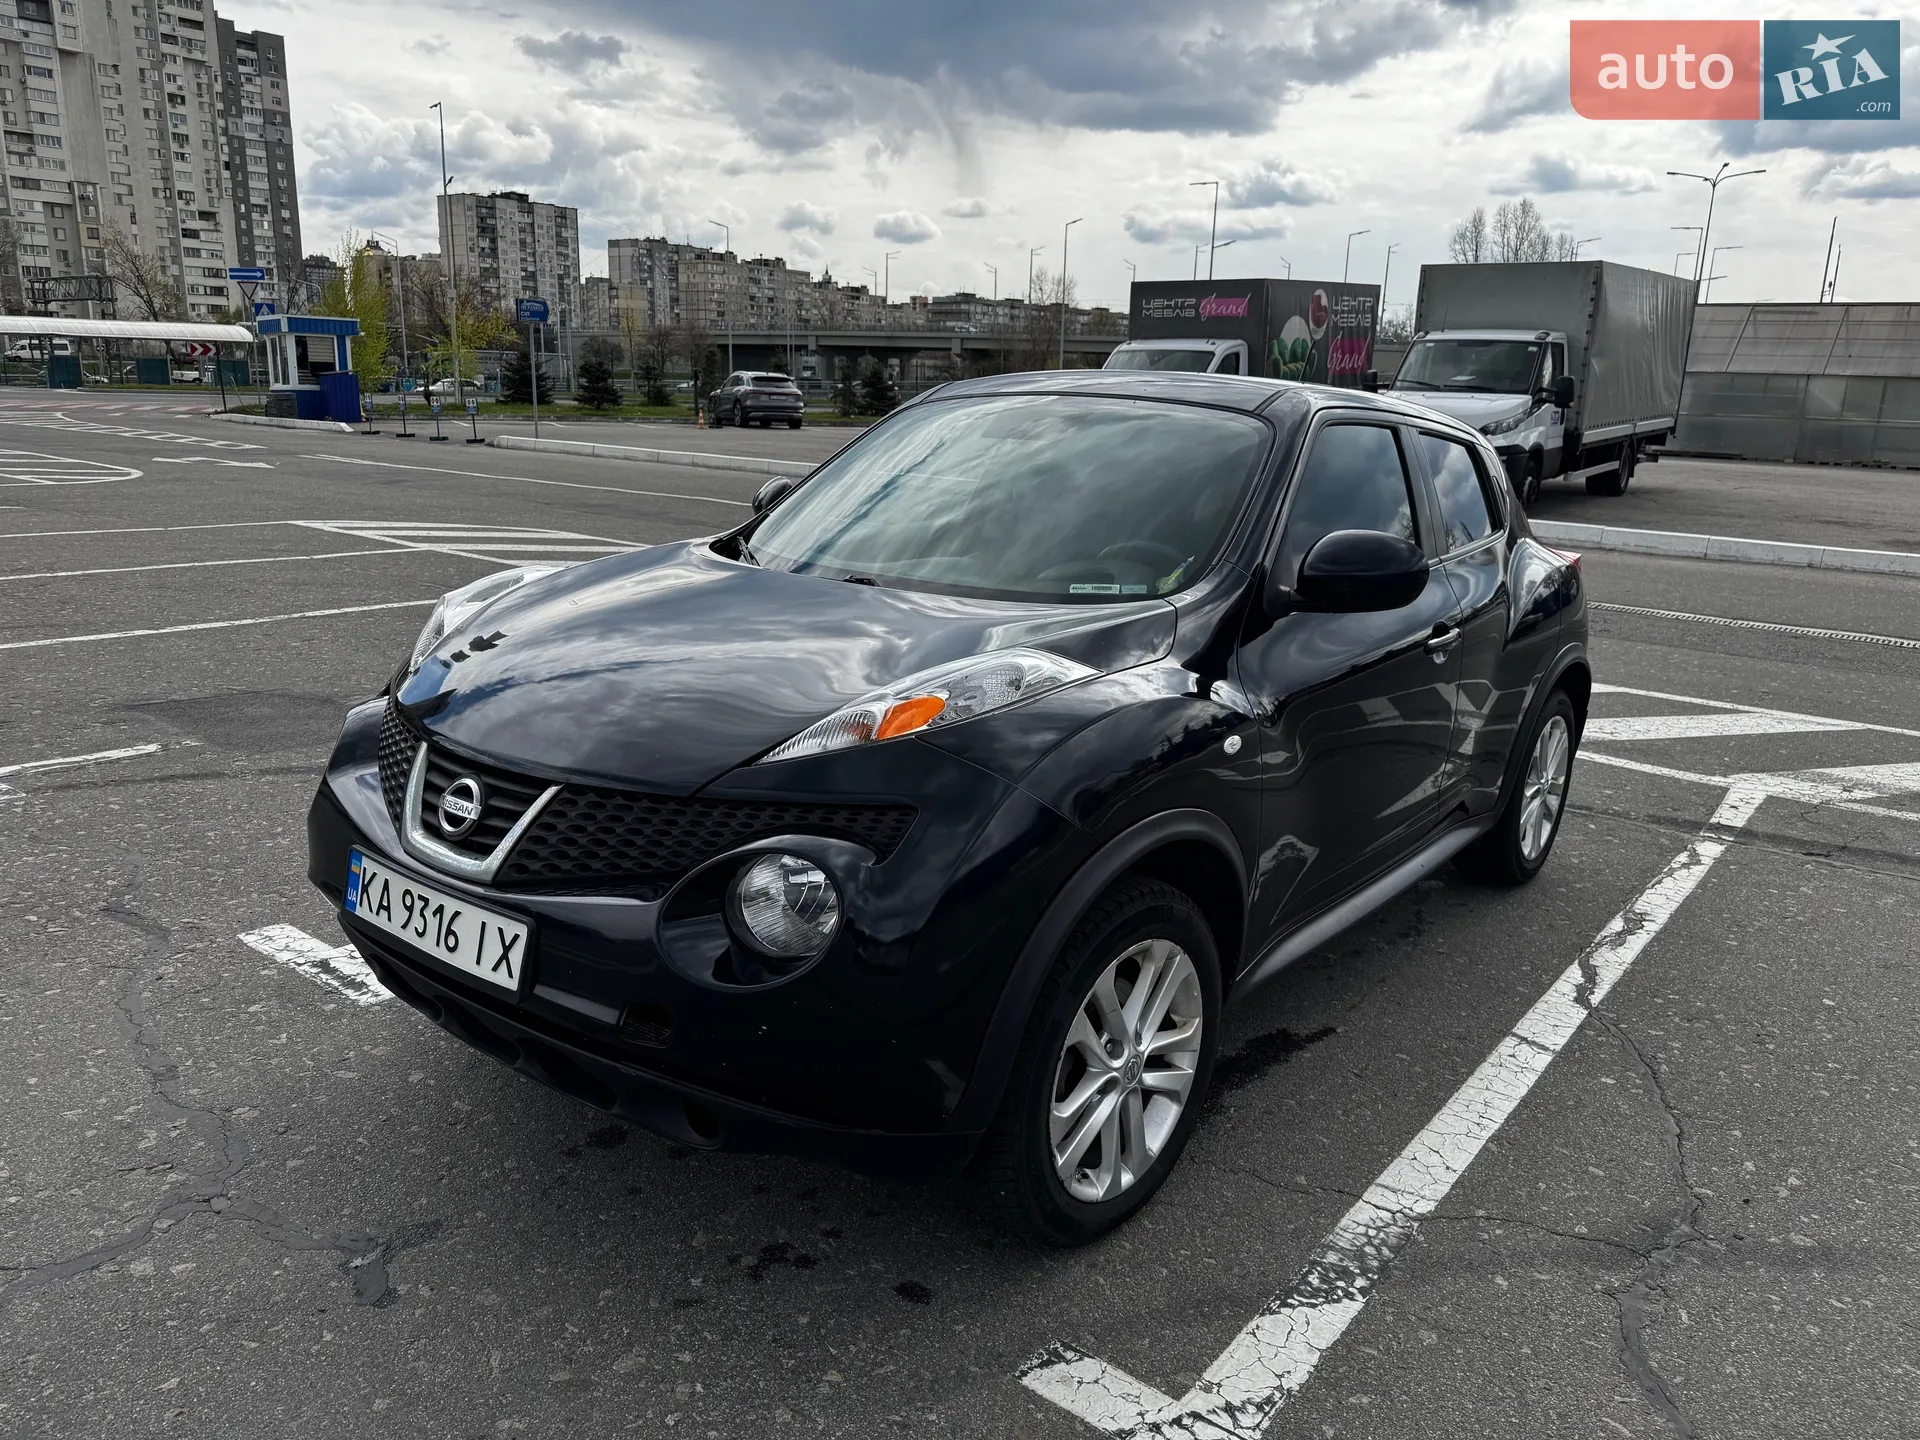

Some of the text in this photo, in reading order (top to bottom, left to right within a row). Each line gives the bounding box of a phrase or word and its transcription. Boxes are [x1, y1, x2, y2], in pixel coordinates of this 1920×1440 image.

[1142, 298, 1196, 309] ЦЕНТР
[1199, 292, 1252, 322] Grand
[1332, 296, 1374, 312] ЦЕНТР
[1142, 308, 1196, 318] МЕБЛІВ
[1330, 313, 1372, 327] МЕБЛІВ
[1327, 330, 1372, 384] Grand
[441, 797, 475, 817] NISSAN
[347, 886, 357, 904] UA
[359, 867, 520, 979] KA 9316 IX
